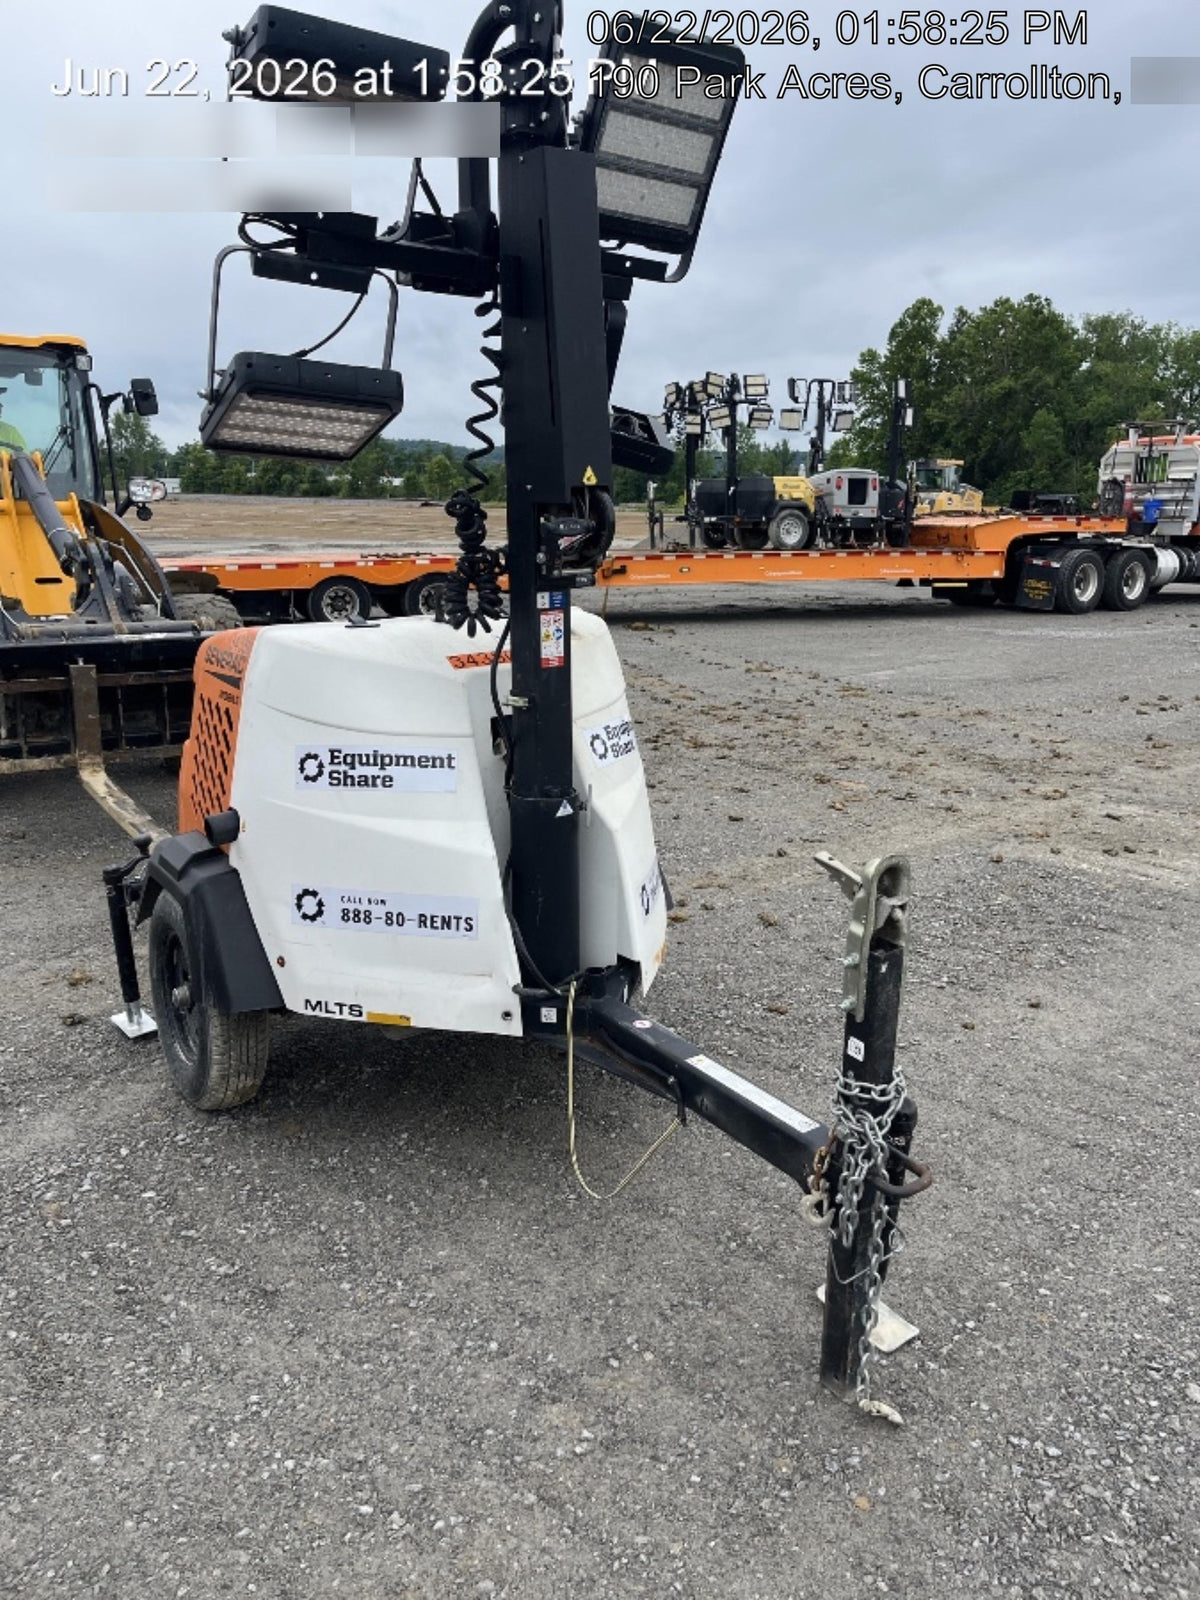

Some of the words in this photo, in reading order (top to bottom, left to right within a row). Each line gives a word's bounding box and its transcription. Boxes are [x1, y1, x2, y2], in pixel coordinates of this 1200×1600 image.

[328, 748, 456, 770] Equipment
[328, 769, 394, 788] Share
[340, 895, 363, 906] CALL
[340, 908, 474, 933] 888-80-RENTS
[304, 998, 364, 1018] MLTS
